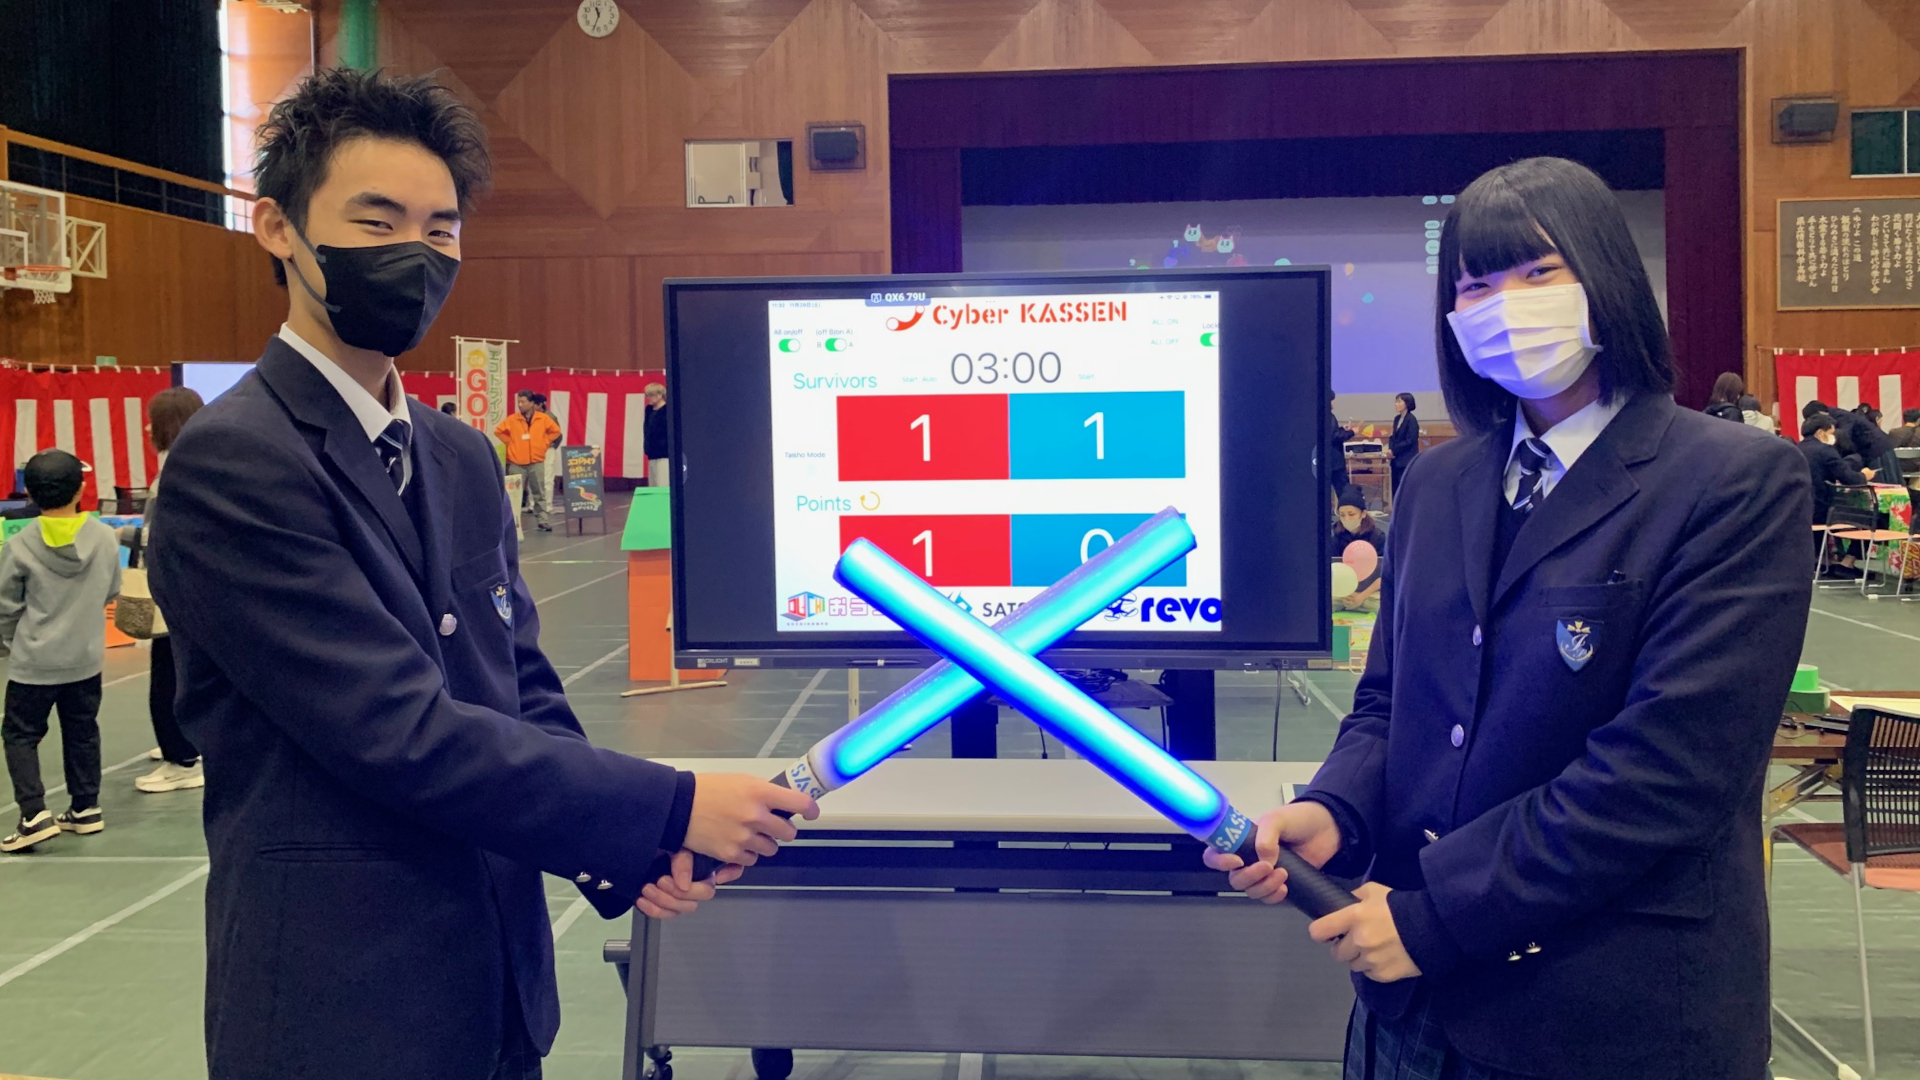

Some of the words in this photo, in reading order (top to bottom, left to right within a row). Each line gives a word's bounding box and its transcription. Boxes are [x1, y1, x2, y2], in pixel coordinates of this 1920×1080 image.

[885, 293, 904, 302] QX6
[907, 292, 926, 301] 79U
[933, 303, 1009, 330] Cyber
[1021, 301, 1127, 323] KASSEN
[793, 372, 877, 390] Survivors
[950, 351, 1062, 385] 03:00
[488, 350, 502, 425] エコドライブ
[910, 414, 931, 462] 1
[1084, 412, 1105, 460] 1
[796, 494, 851, 512] Points
[912, 530, 933, 577] 1
[982, 602, 1027, 617] SAT
